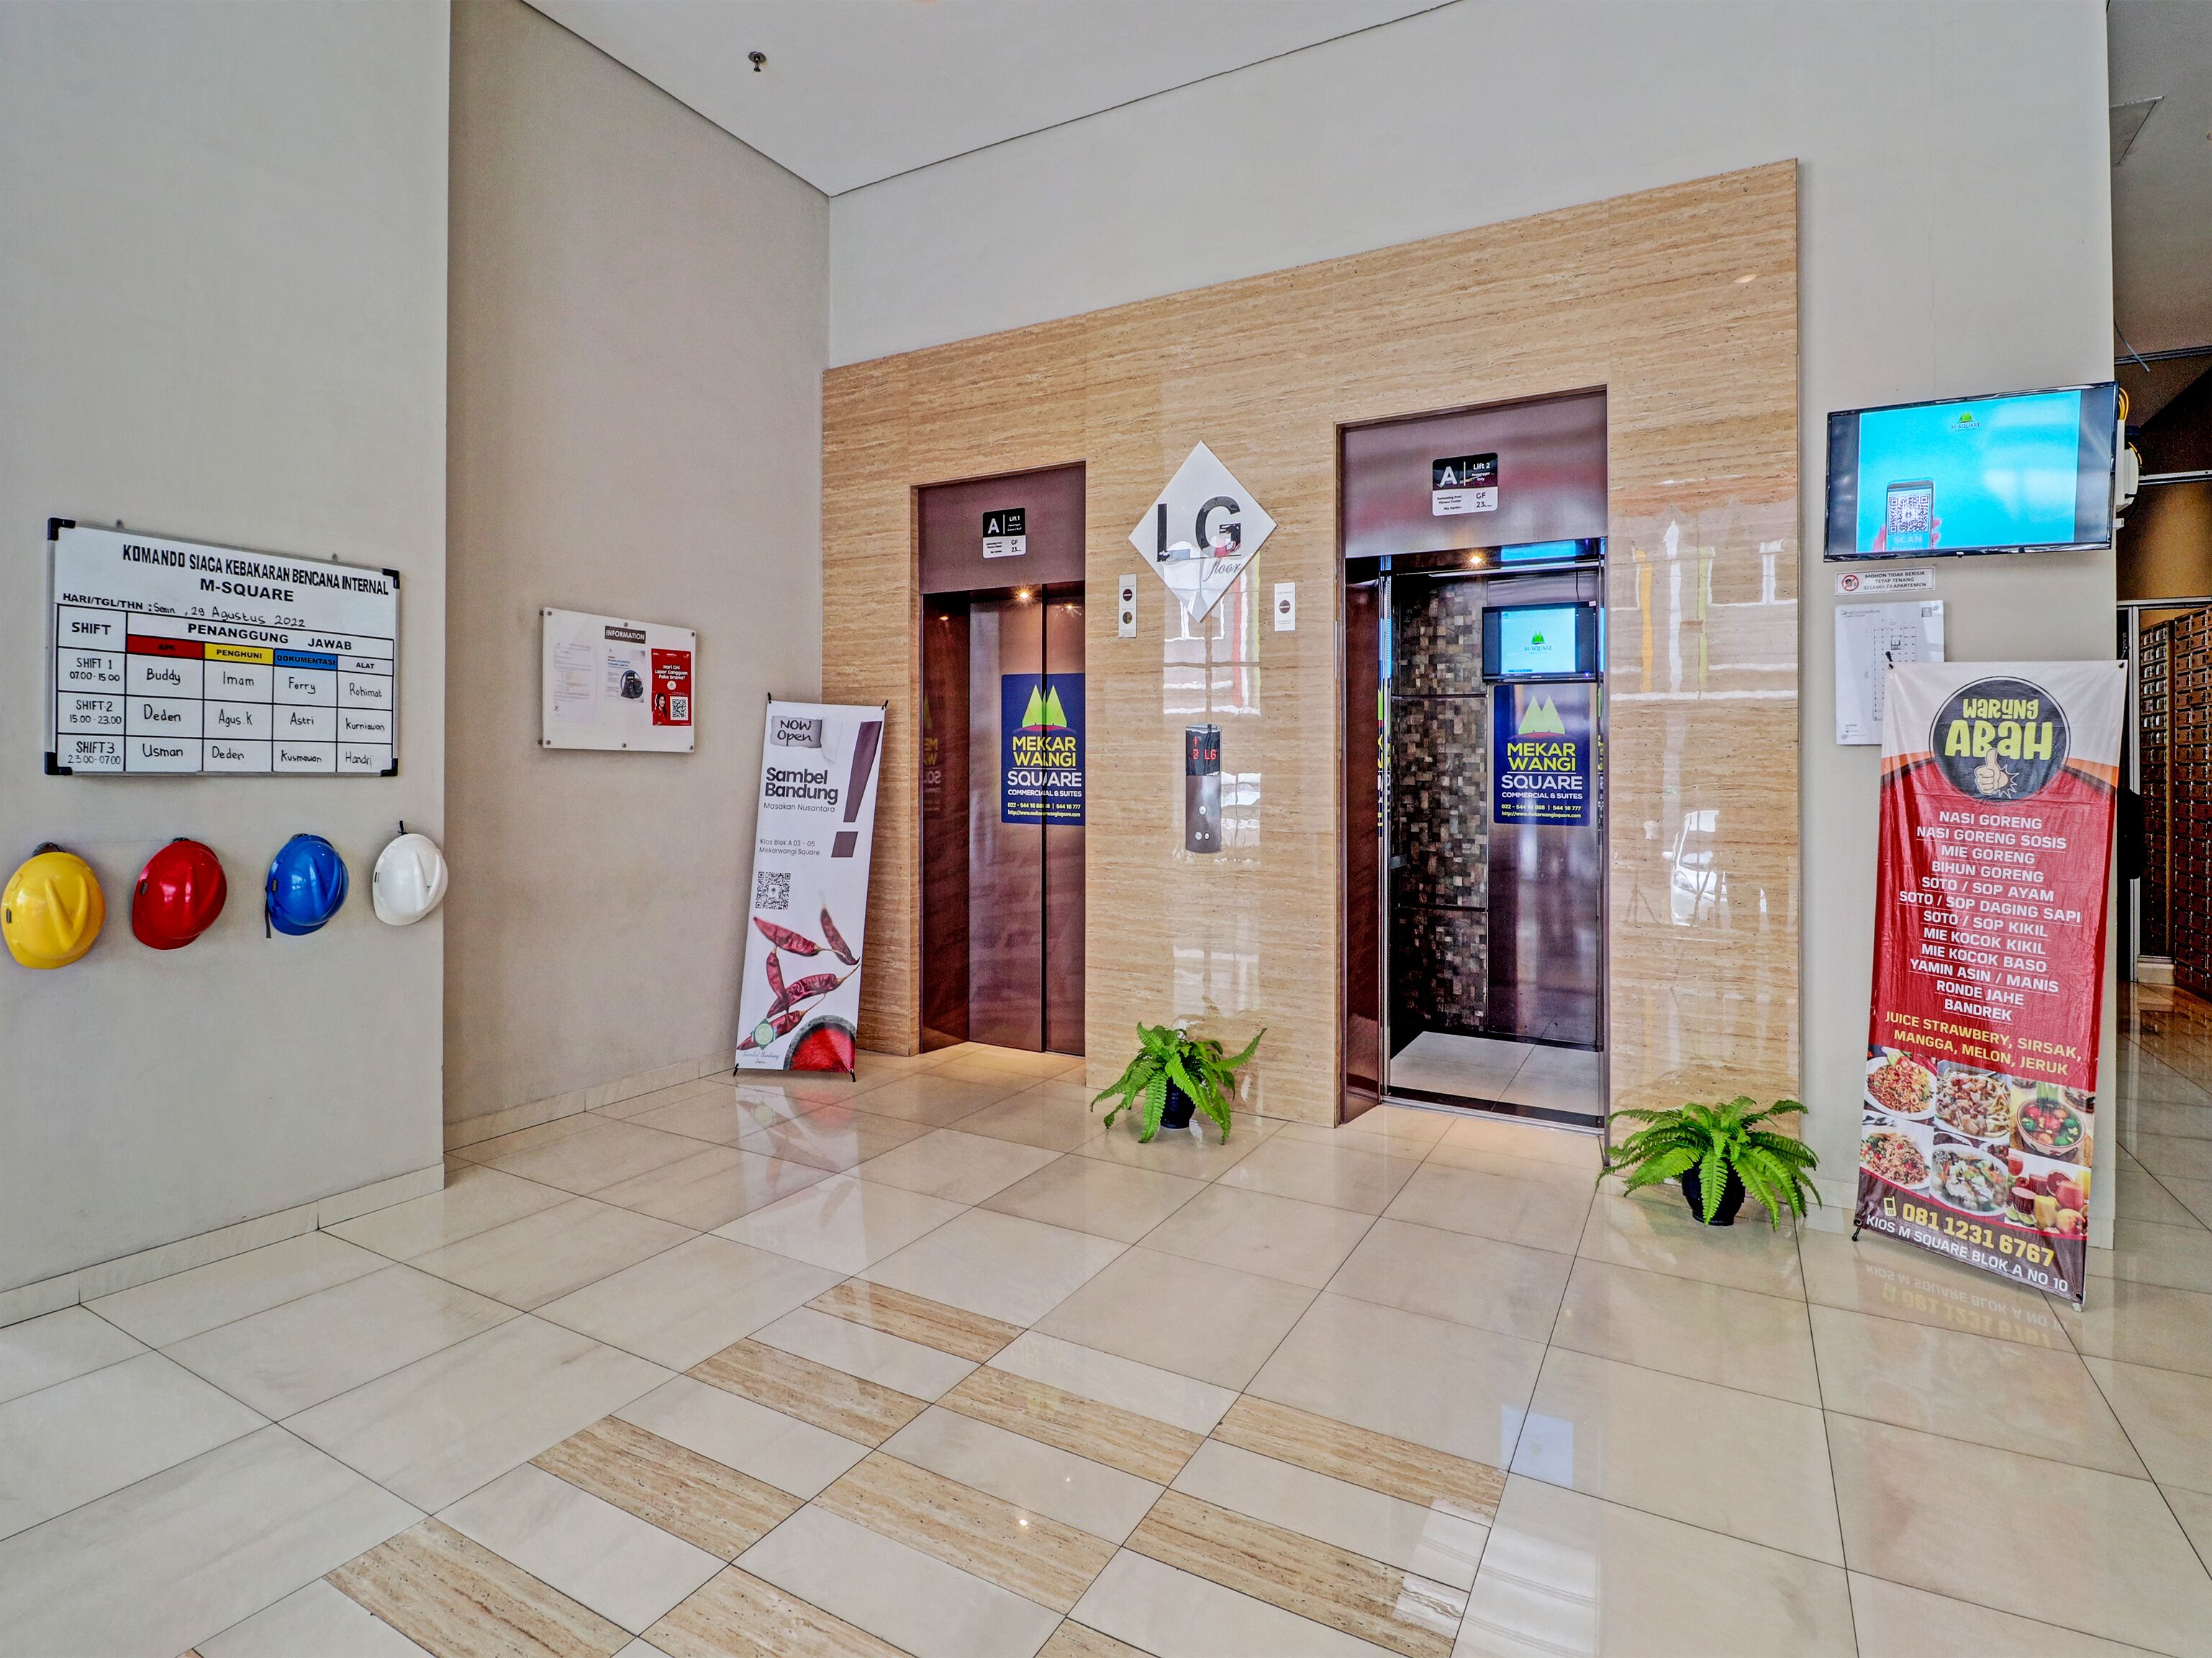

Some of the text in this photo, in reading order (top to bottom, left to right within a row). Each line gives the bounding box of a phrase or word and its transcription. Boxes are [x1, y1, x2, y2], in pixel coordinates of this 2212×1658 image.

[1440, 466, 1457, 487] A
[988, 518, 1000, 534] A
[1156, 496, 1241, 562] LG
[1894, 535, 1922, 544] SCAN
[123, 544, 389, 595] KOMANDO SIAGA KEBAKARAN BENCANA INTERNAL
[1202, 557, 1241, 581] floor
[200, 578, 294, 602] M-SQUARE
[63, 593, 142, 610] HARI/TGL/THN
[212, 606, 266, 624] Agustus
[275, 615, 305, 627] 2022
[72, 622, 111, 635] SHIFT
[188, 623, 352, 650] PENANGGUNG JAWAB
[606, 630, 645, 640] INFORMATION
[217, 650, 262, 658] PENGHUNI
[277, 655, 335, 665] DOKUMENTASI
[76, 658, 112, 669] SHIFT 1
[147, 668, 181, 685] Buddy
[223, 671, 254, 686] Imam
[289, 676, 316, 694] Ferry
[76, 700, 104, 710] SHIFT
[144, 704, 181, 722] Deden
[290, 712, 314, 725] Astri
[76, 741, 105, 753] SHIFT
[777, 730, 812, 746] Open
[142, 743, 183, 757] Usman
[212, 746, 244, 760] Deden
[1508, 743, 1576, 756] MEKAR
[1508, 757, 1576, 771] WANGI
[766, 766, 828, 784] Sambel
[1007, 771, 1082, 787] SQUARE
[1501, 775, 1582, 789] SQUARE
[765, 782, 838, 805] Bandung
[1939, 811, 2042, 830] NASI GORENG
[1917, 826, 2066, 848] NASI GORENG SOSIS
[759, 847, 797, 856] Mekarwangi
[1941, 846, 2036, 864] MIE GORENG
[1932, 861, 2044, 883] BIHUN GORENG
[1922, 876, 2054, 902] SOTO SOP AYAM
[1900, 891, 2081, 923] SOTO SOP DAGING SAPI
[1923, 911, 2048, 937] SOTO SOP KIKIL
[1923, 928, 2046, 955] MIE KOCOK KIKIL
[1921, 943, 2047, 973] MIE KOCOK BASO
[1910, 959, 1953, 976] YAMIN
[1957, 966, 1991, 983] ASIN
[2006, 975, 2059, 993] MANIS
[1936, 979, 2024, 1006] RONDE JAHE
[1944, 998, 2013, 1022] BANDREK
[1885, 1010, 2082, 1061] JUICE STRAWBERY, SIRSAK,
[1894, 1029, 2068, 1076] MANGGA, MELON, JERUK
[1902, 1202, 2055, 1267] 081 1231 6767
[1866, 1214, 2068, 1292] KIOS M SQUARE BLOK A NO 10
